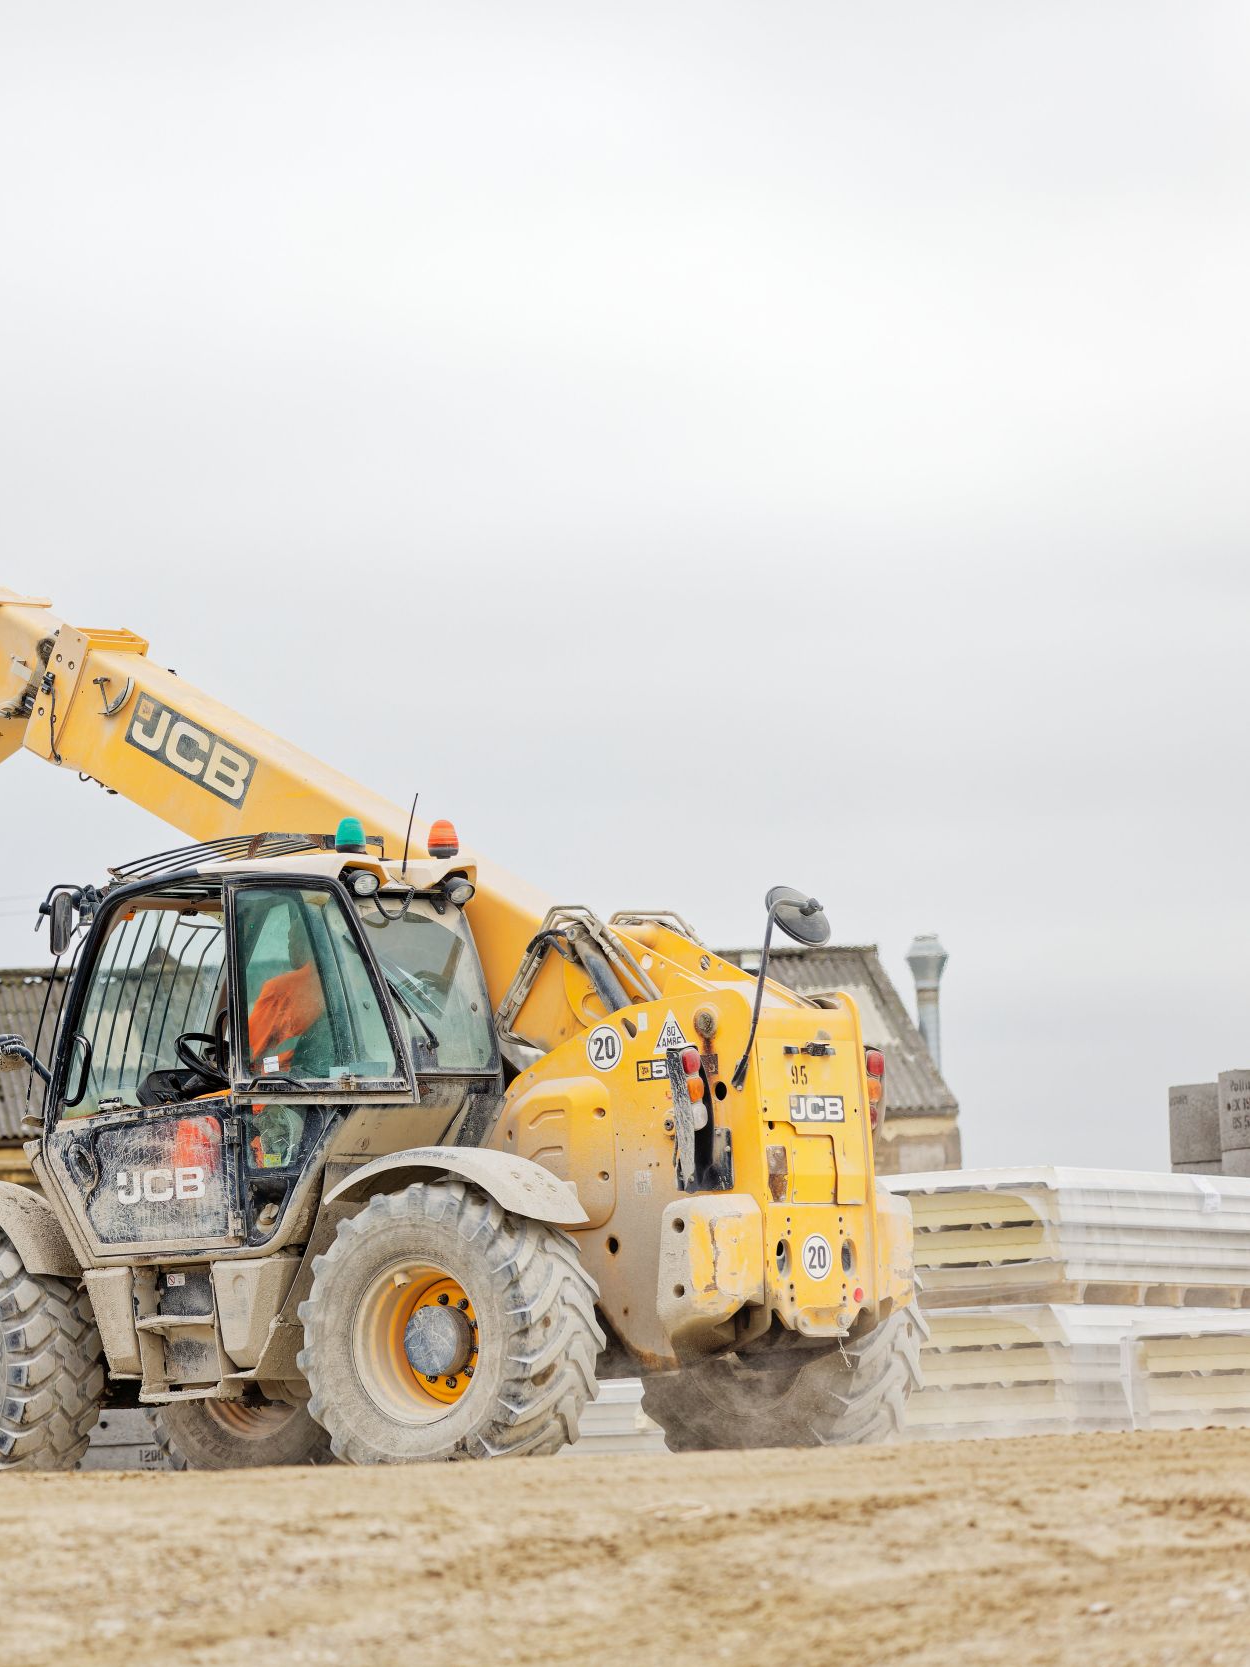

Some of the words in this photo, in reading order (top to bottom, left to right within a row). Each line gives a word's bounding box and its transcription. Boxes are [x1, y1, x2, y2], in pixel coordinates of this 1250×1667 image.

[131, 710, 250, 800] JCB
[593, 1035, 616, 1061] 20
[791, 1065, 808, 1085] 95
[791, 1097, 844, 1121] JCB
[117, 1166, 206, 1204] JCB
[807, 1245, 827, 1269] 20
